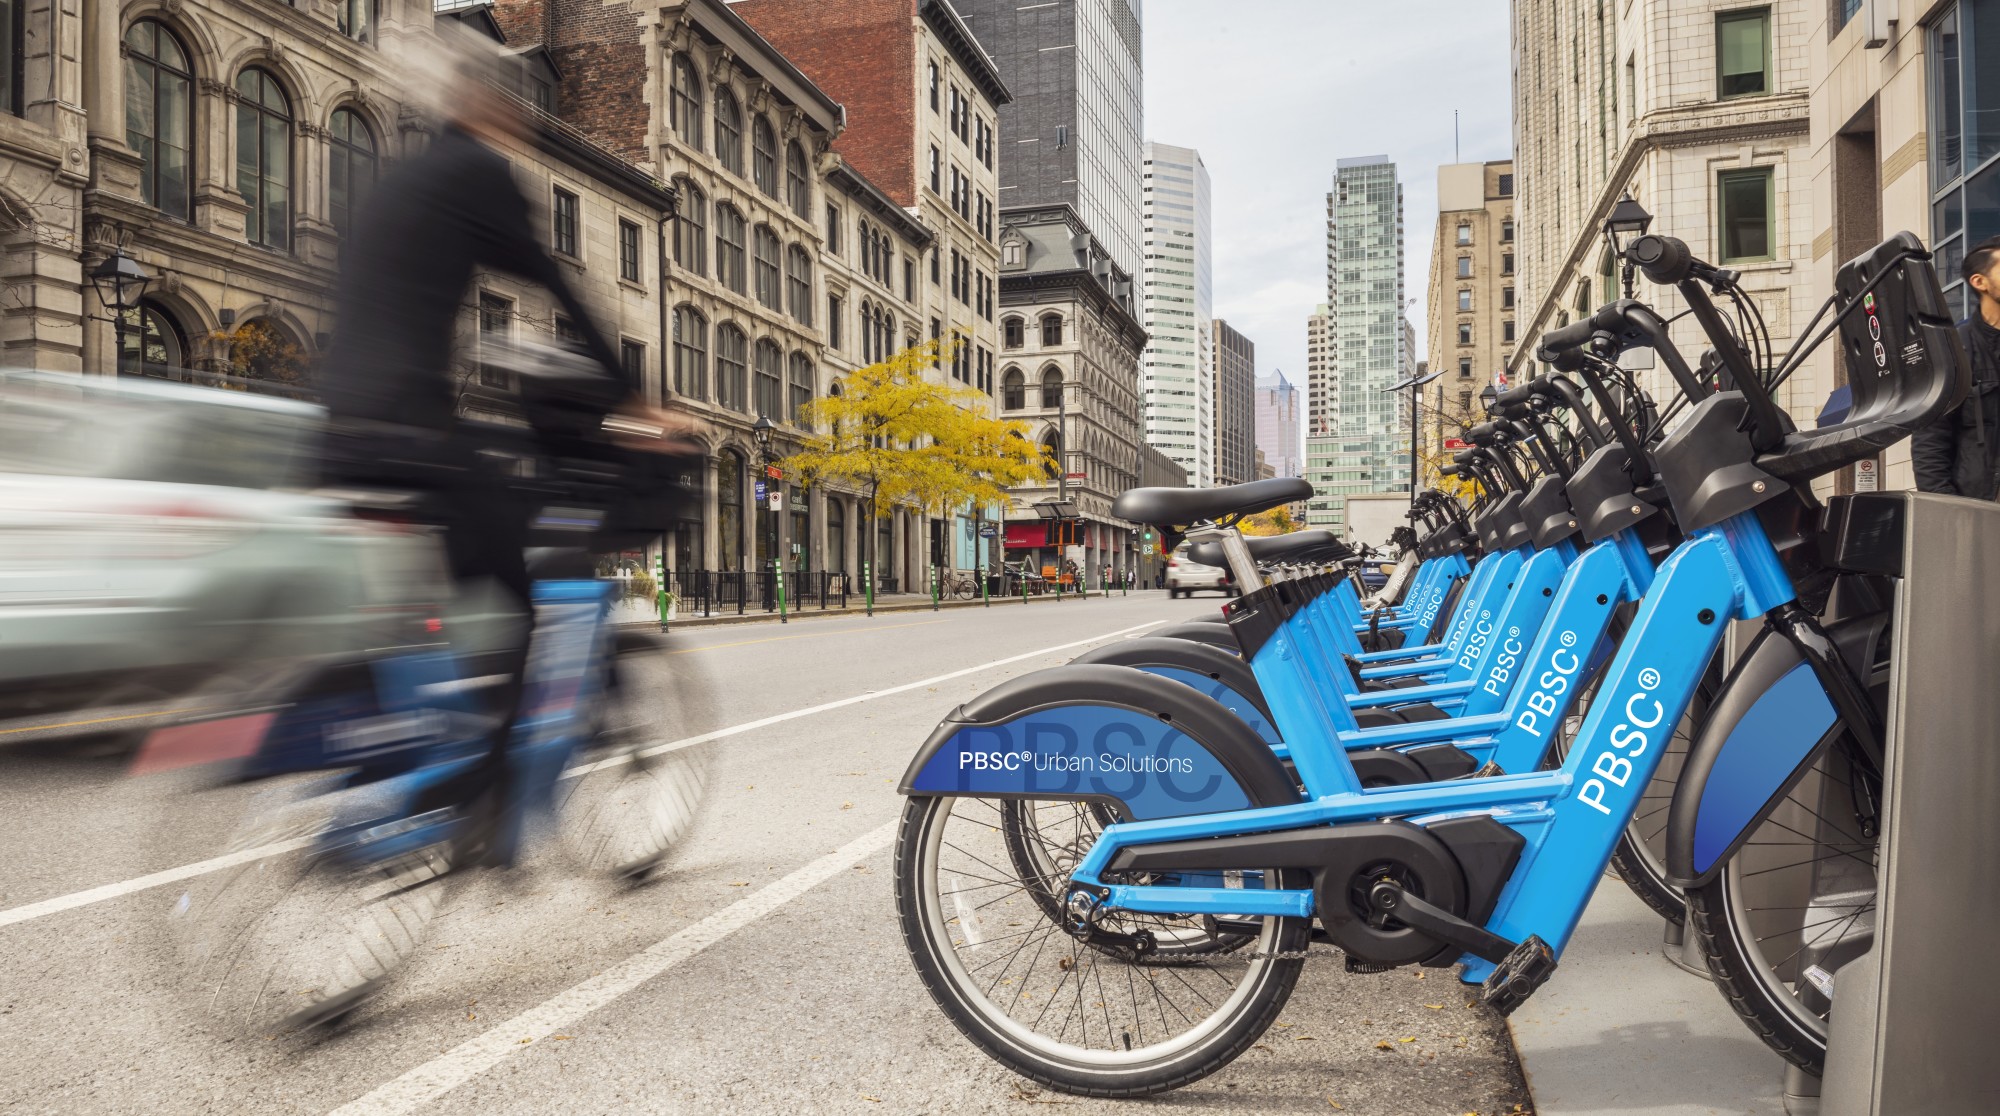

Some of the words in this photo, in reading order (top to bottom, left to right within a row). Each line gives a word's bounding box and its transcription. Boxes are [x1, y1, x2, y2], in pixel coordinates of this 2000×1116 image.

[1459, 609, 1493, 671] PBSC®
[1483, 626, 1522, 696] PBSC®
[1516, 630, 1579, 737] PBSC®
[1034, 752, 1093, 772] Urban
[1098, 752, 1193, 774] Solutions
[1577, 667, 1663, 815] PBSC®
